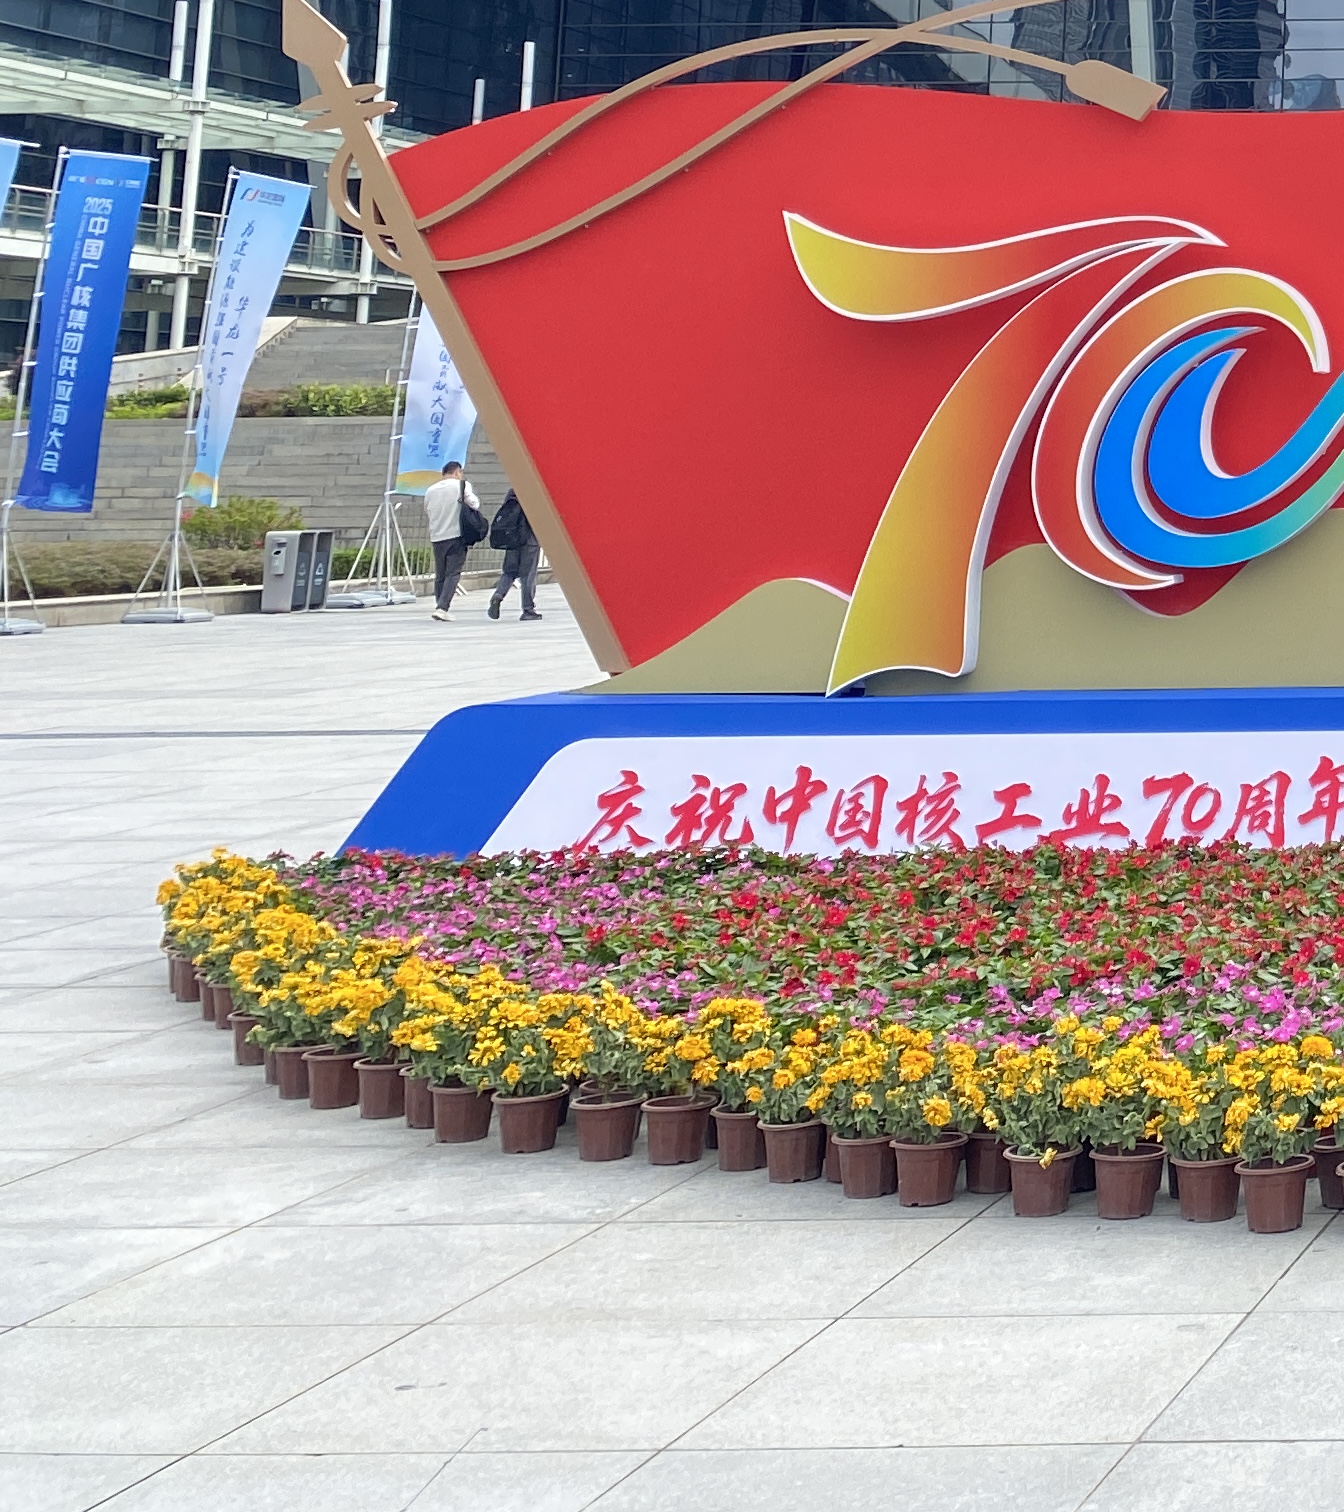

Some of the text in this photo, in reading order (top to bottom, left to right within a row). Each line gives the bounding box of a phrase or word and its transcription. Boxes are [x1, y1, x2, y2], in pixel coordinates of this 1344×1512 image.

[83, 196, 114, 215] 2025
[40, 216, 109, 474] 中国广核集团供应商大会
